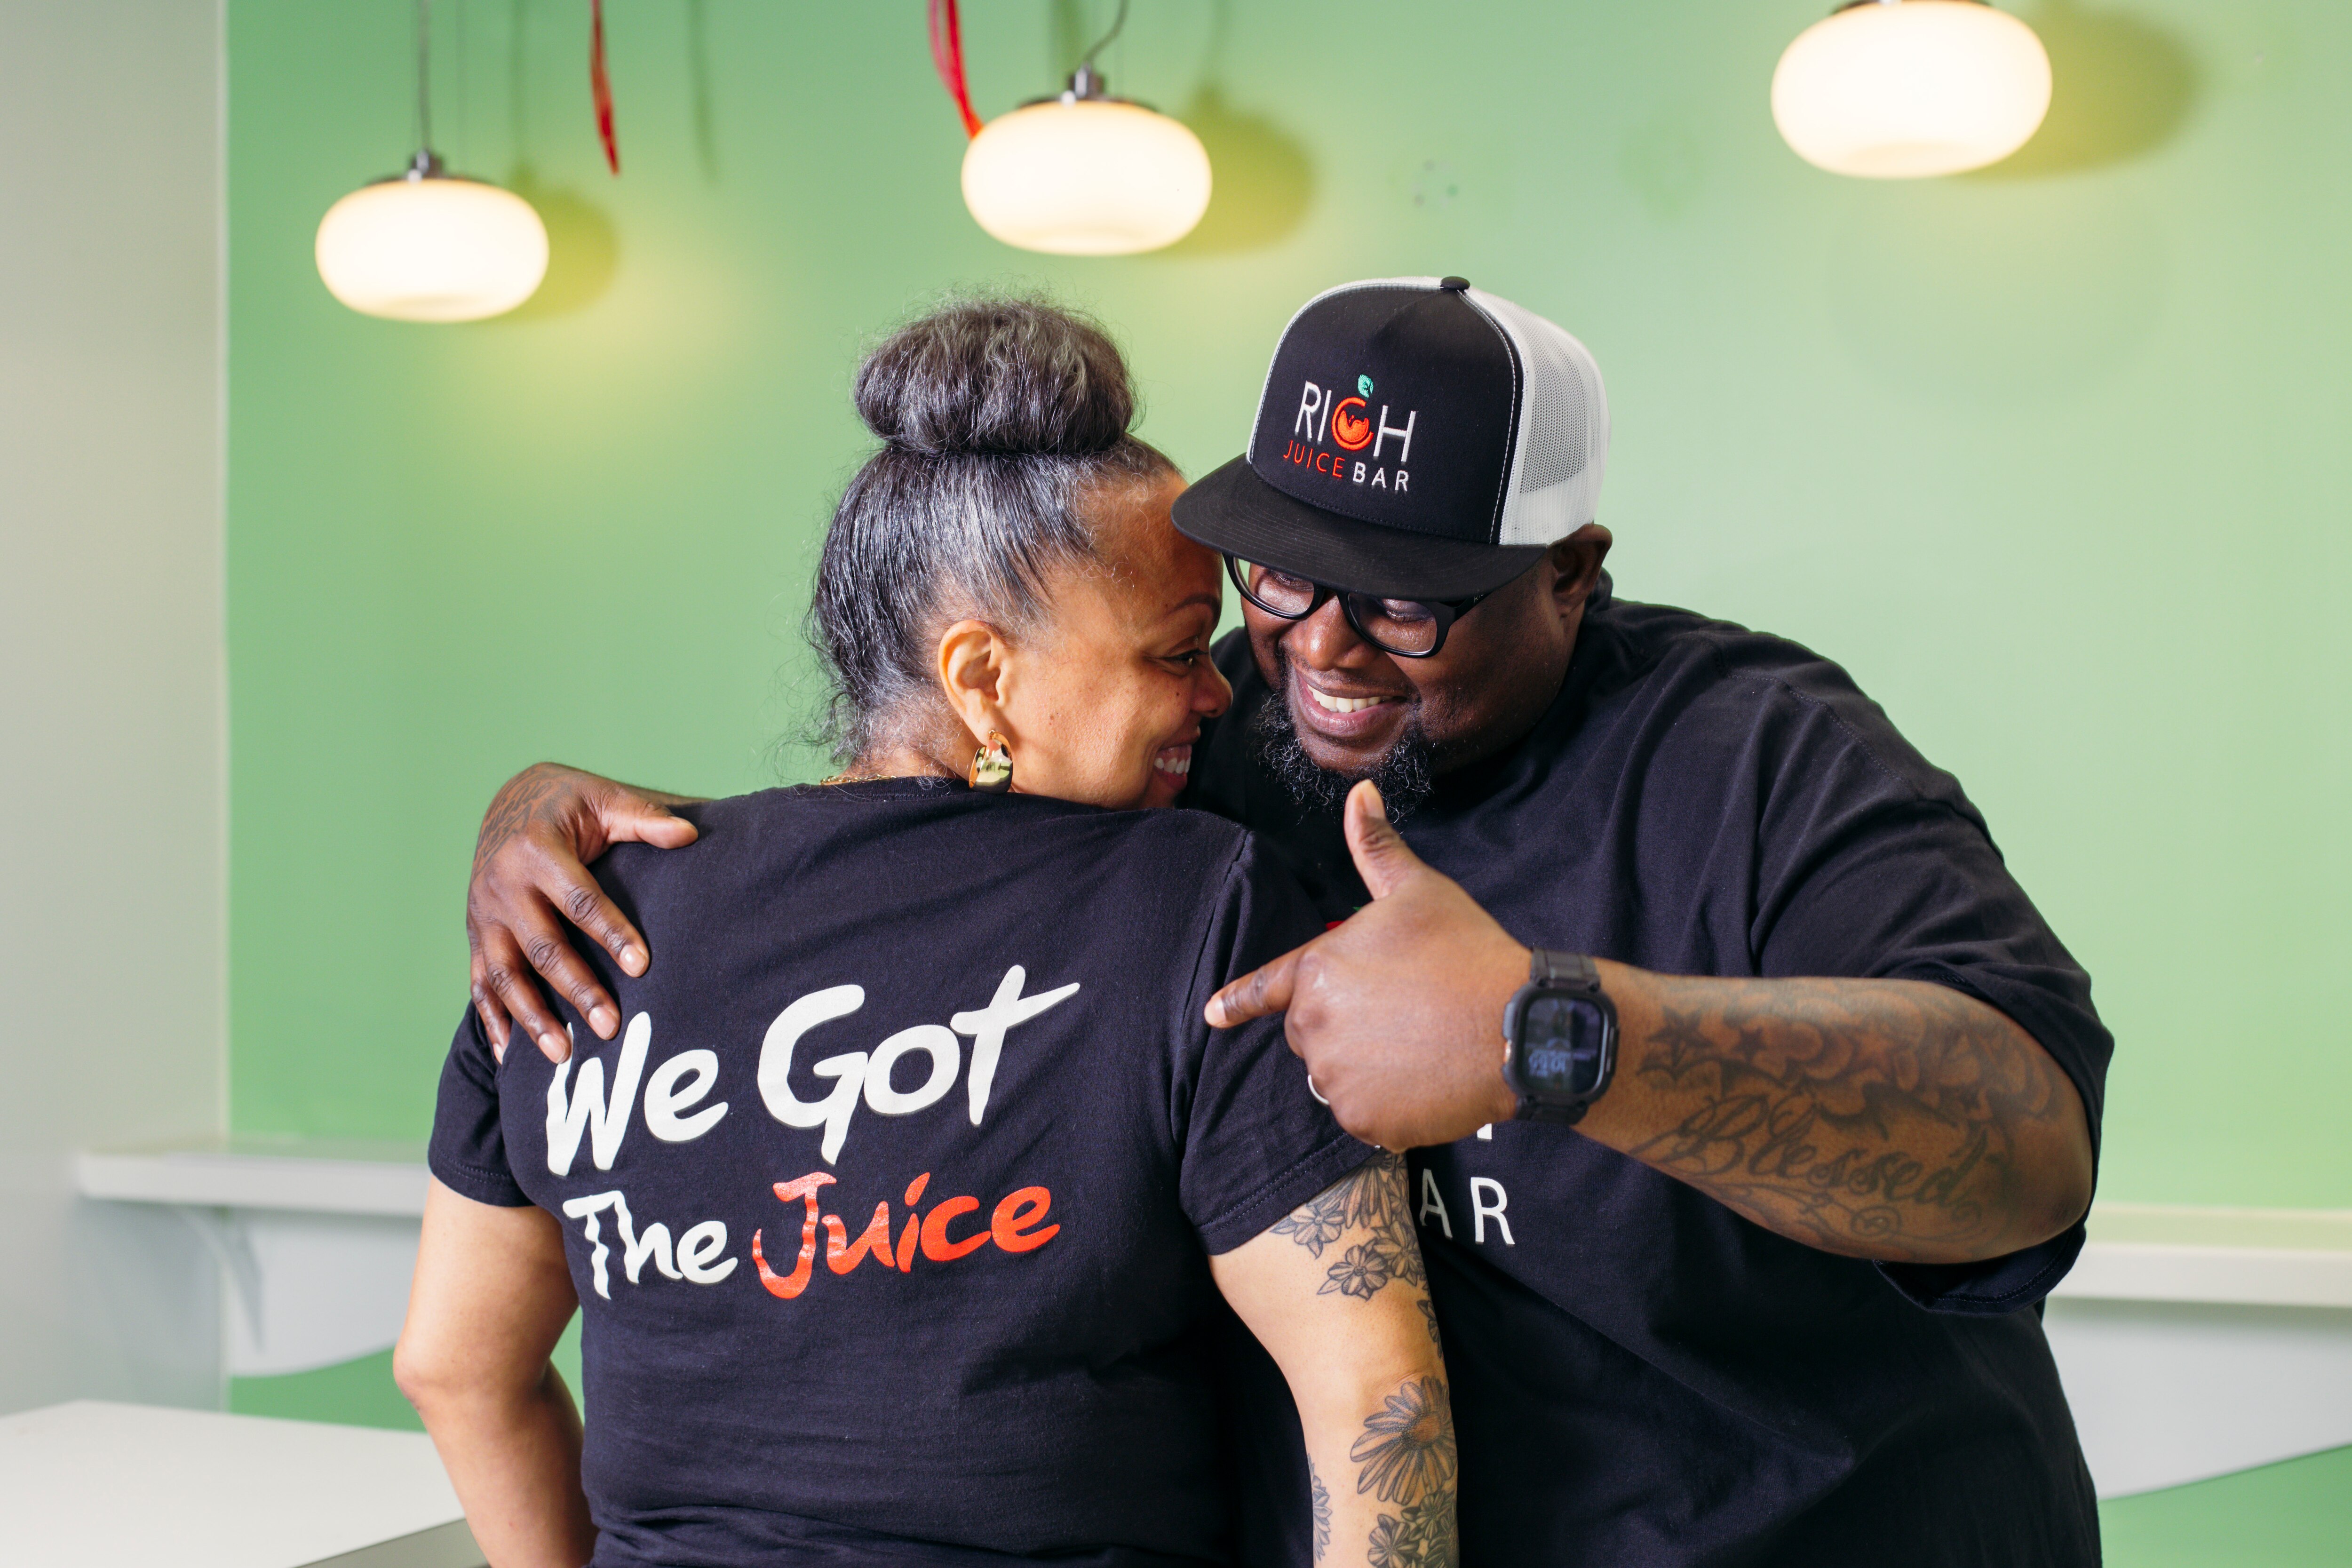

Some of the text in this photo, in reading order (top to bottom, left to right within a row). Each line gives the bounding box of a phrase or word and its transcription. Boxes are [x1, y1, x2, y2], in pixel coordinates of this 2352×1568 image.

[1283, 440, 1409, 492] JUICE BAR
[1295, 381, 1416, 462] RICH
[546, 964, 1081, 1177] We Got
[1632, 1092, 1989, 1207] Blessed
[563, 1172, 1061, 1300] The Juice
[1419, 1169, 1515, 1245] AR
